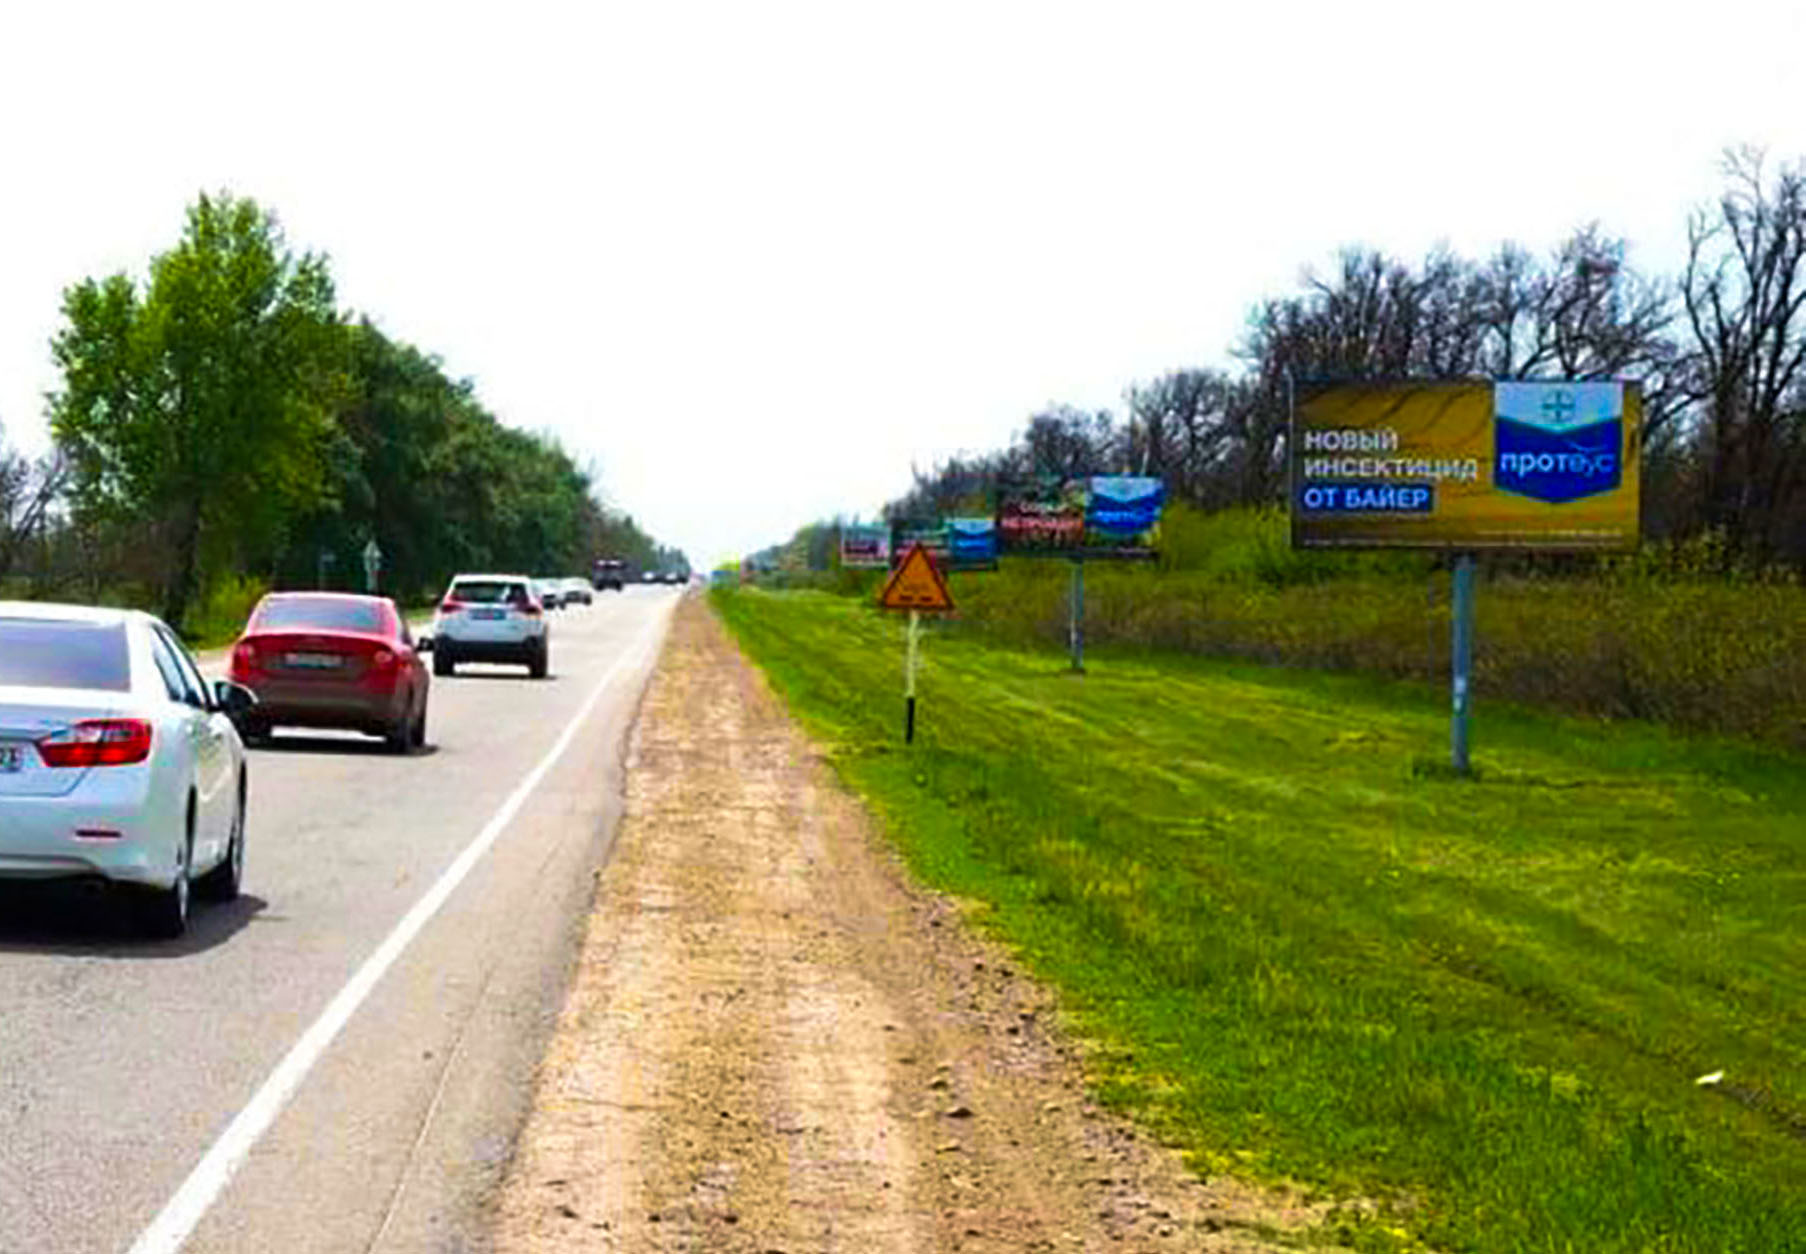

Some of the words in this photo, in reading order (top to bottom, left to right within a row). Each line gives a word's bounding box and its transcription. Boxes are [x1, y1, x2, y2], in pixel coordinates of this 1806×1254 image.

[1304, 427, 1398, 450] НОВЫЙ
[1304, 458, 1478, 482] ИНСЕКТИЦИД
[1304, 488, 1336, 507] ОТ
[1345, 484, 1429, 507] БАЙЕР
